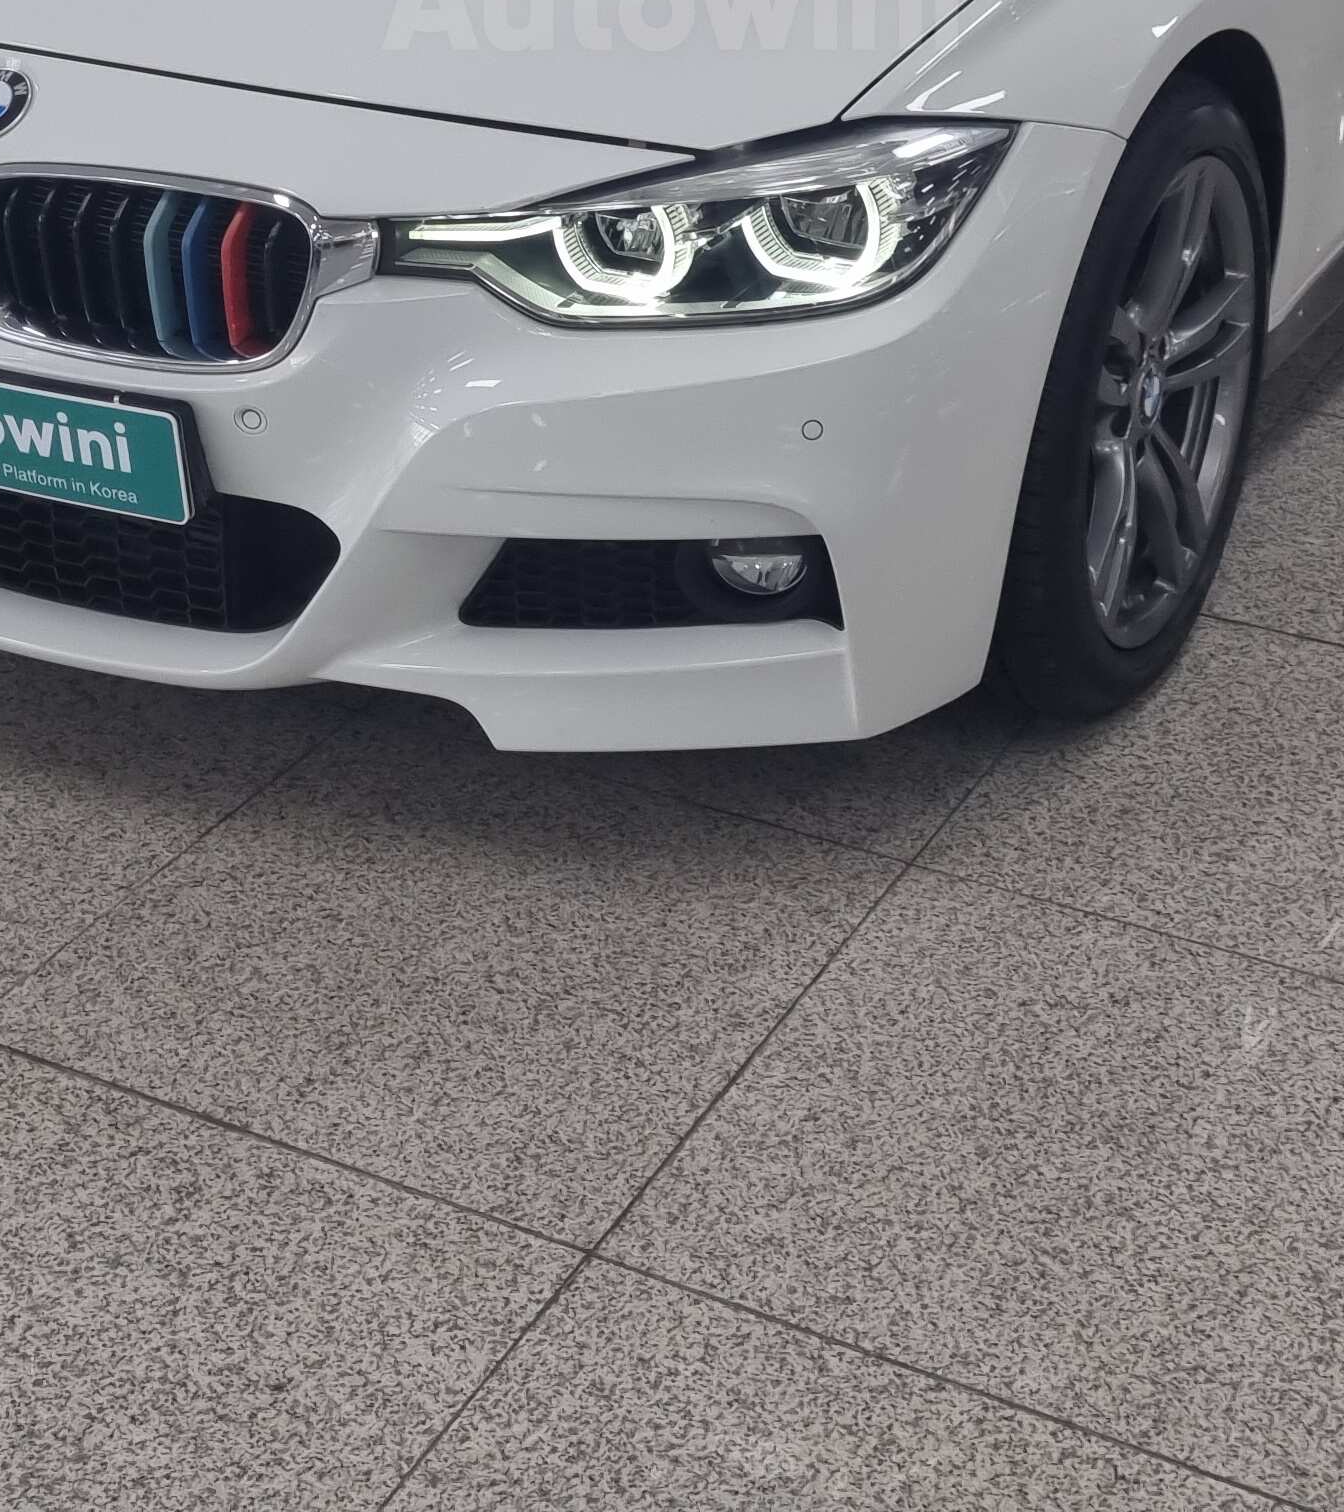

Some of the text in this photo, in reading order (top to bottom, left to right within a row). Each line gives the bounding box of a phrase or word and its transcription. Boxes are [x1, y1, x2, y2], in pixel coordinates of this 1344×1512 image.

[3, 463, 68, 489] Platform
[71, 477, 86, 493] in
[89, 481, 138, 504] Korea
